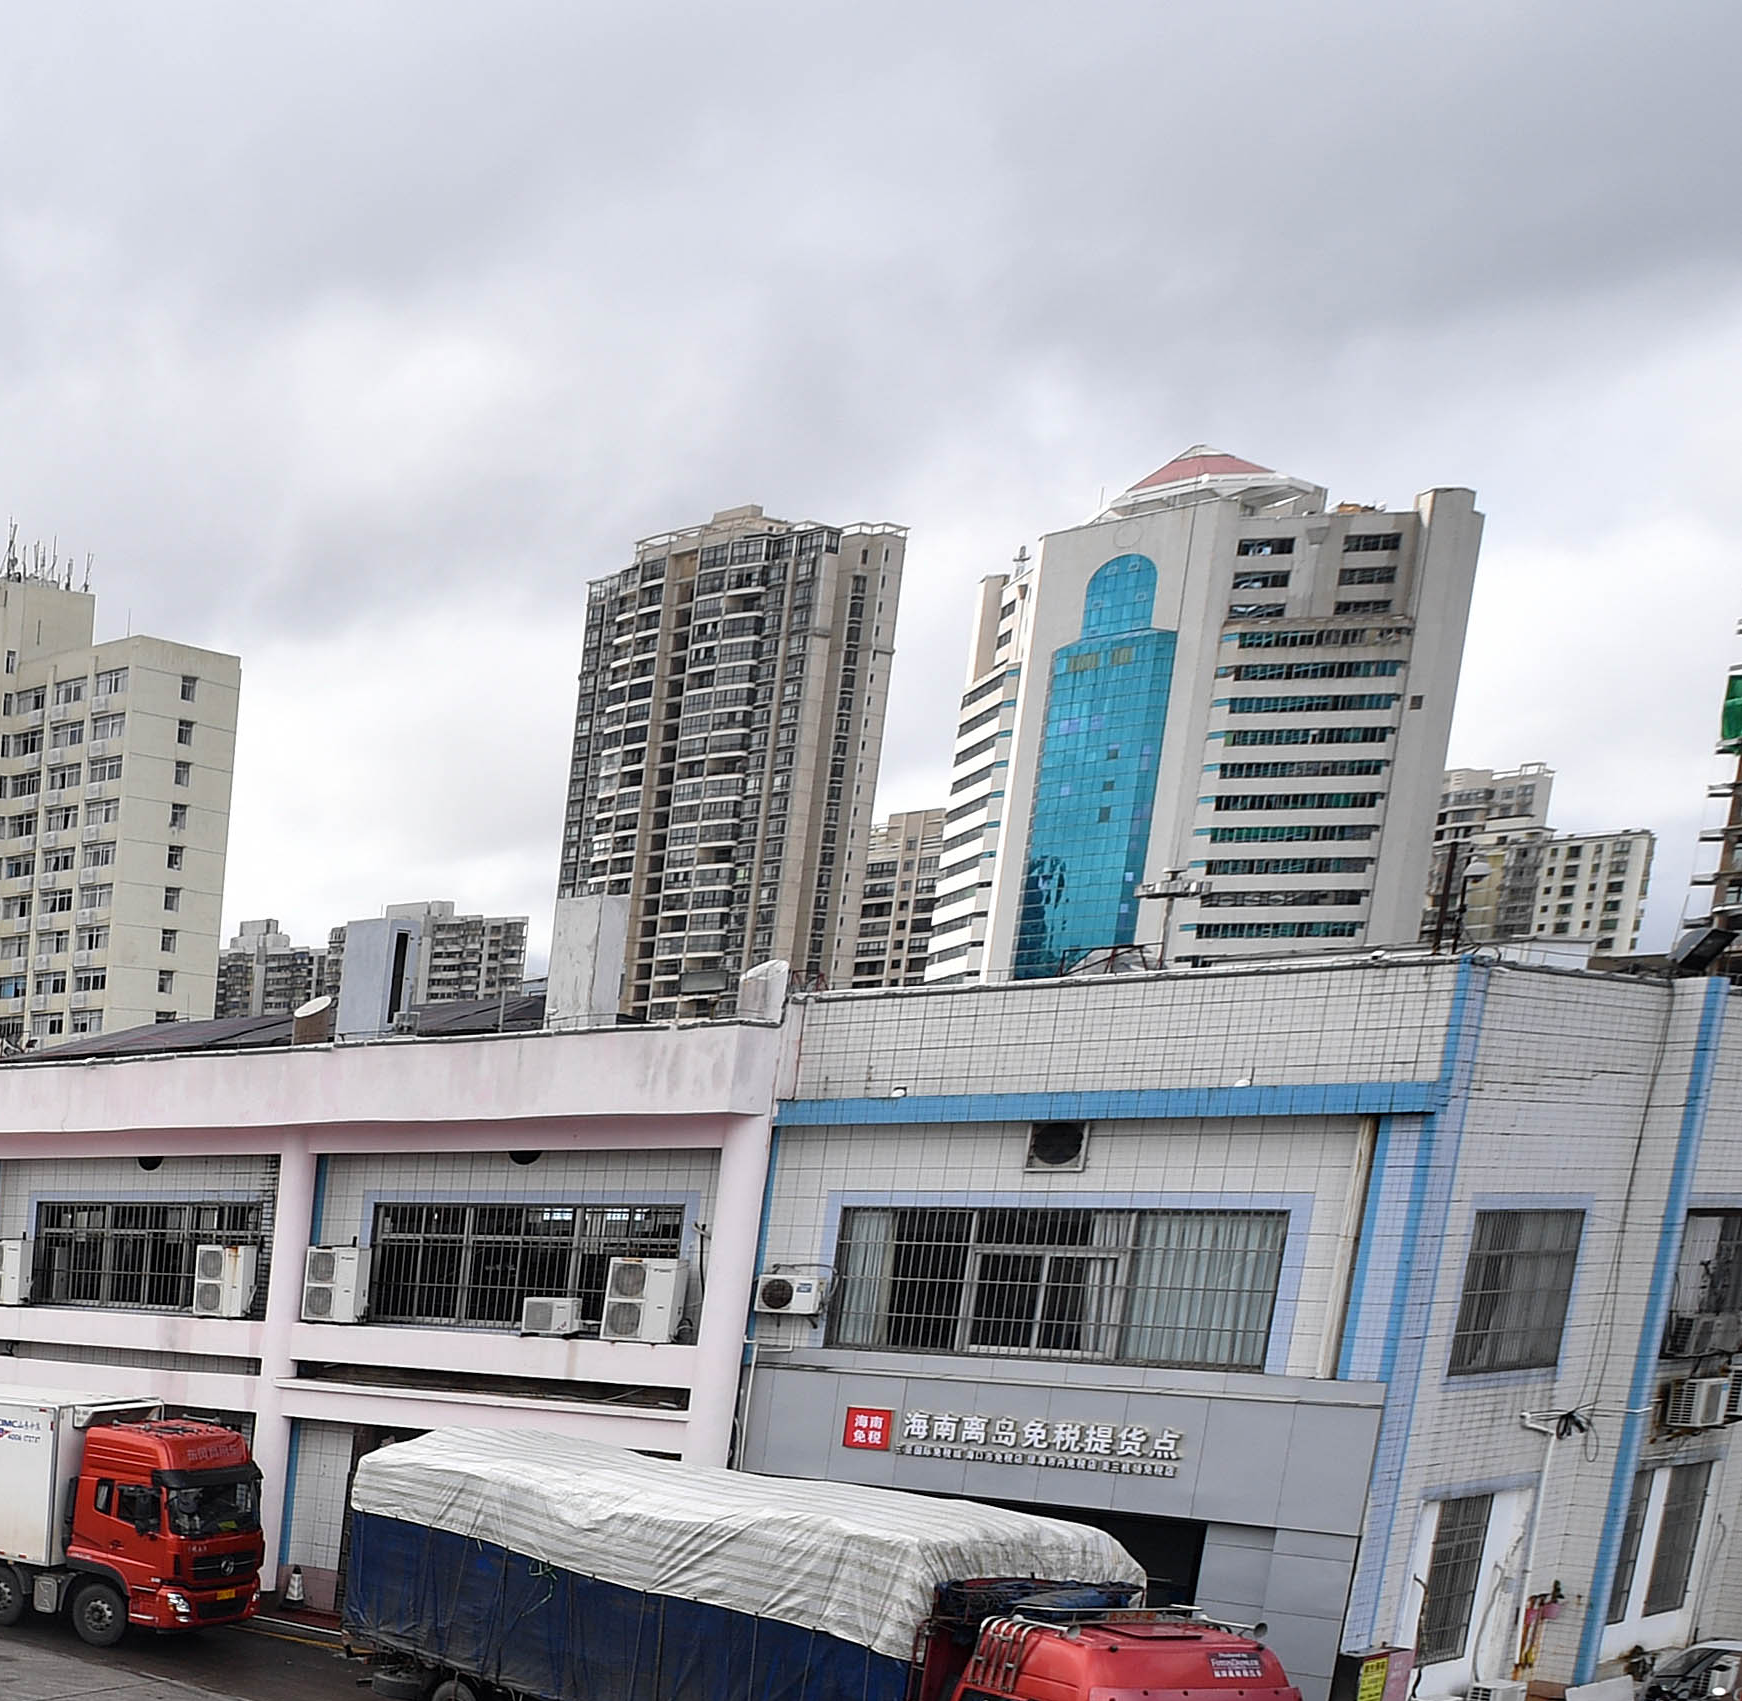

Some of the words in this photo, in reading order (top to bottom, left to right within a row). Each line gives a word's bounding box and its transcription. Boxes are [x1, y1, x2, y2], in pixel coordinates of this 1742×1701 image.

[854, 1414, 884, 1430] 海南
[852, 1429, 883, 1445] 免税
[904, 1411, 1183, 1461] 海南离岛免税提货点
